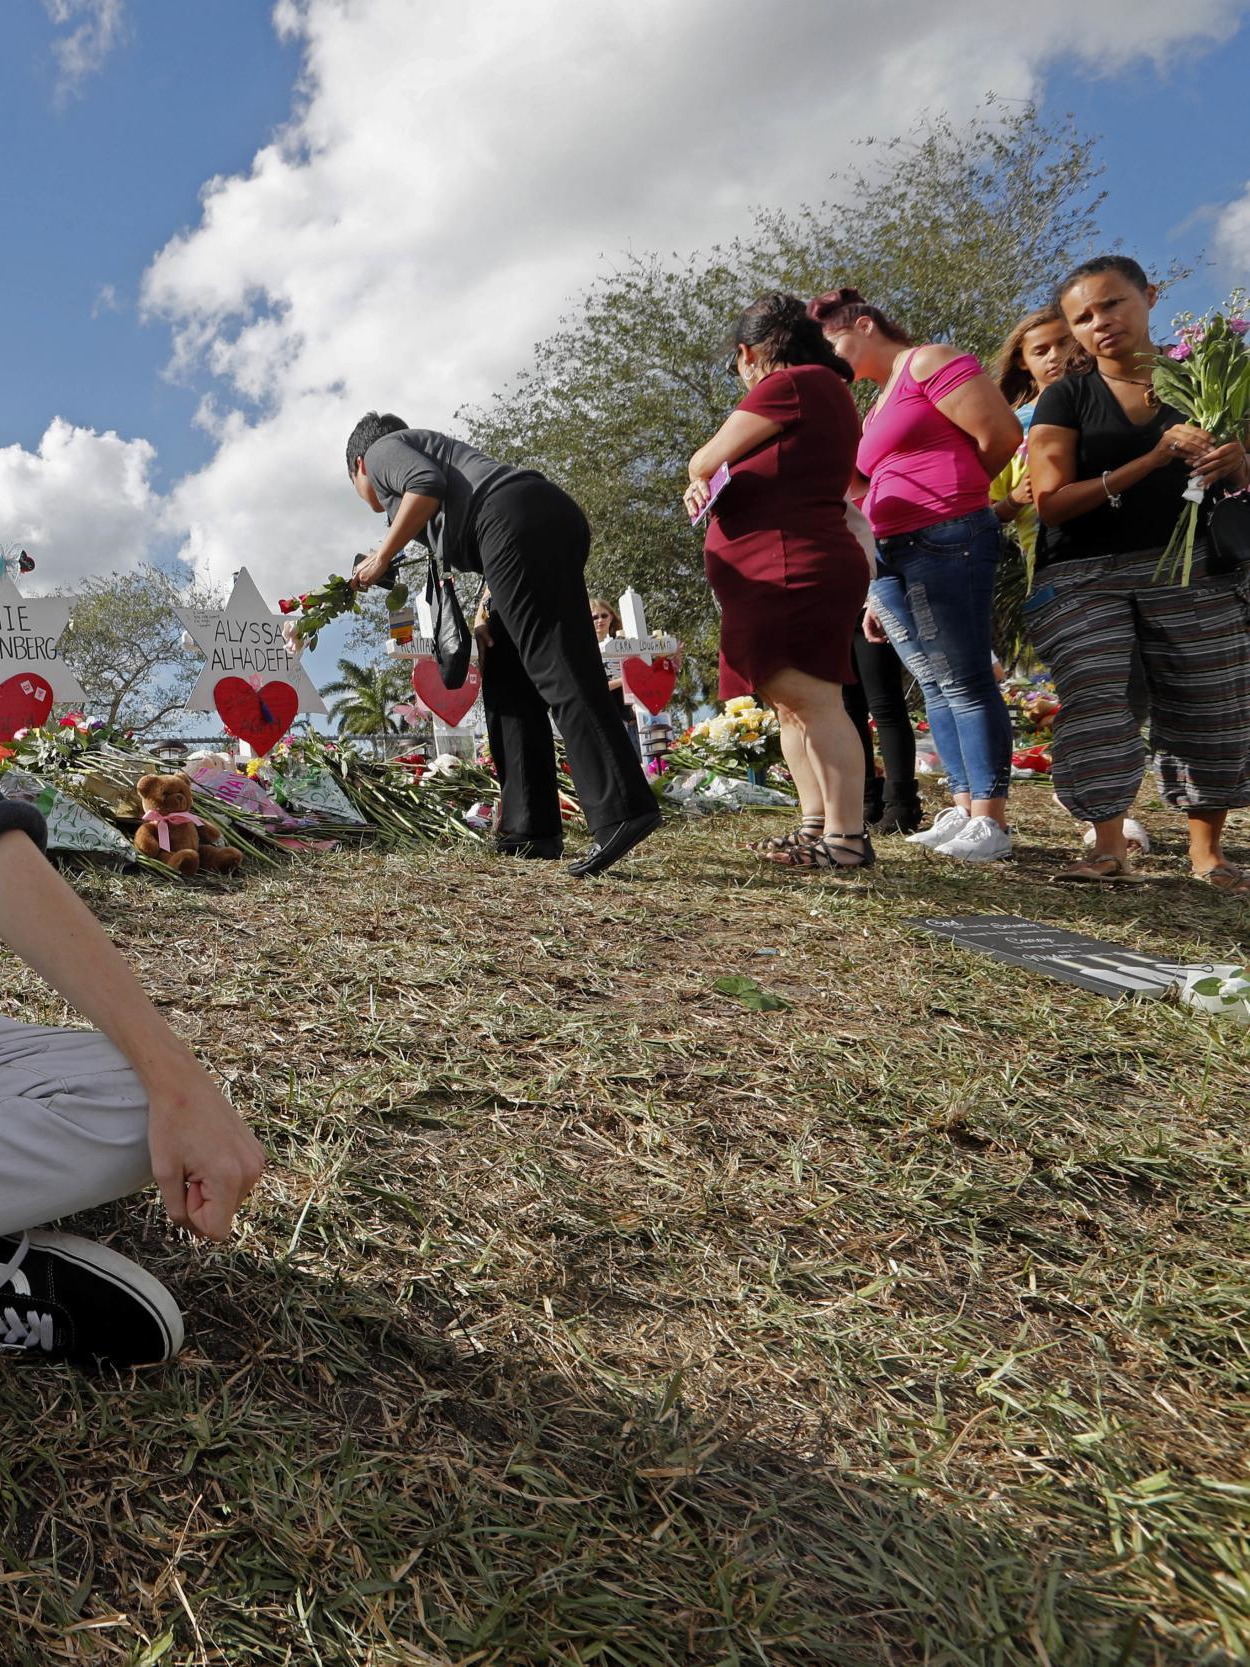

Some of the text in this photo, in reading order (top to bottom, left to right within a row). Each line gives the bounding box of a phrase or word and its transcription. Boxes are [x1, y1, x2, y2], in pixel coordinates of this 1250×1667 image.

[214, 619, 286, 645] ALYSSA
[614, 640, 632, 652] CARA
[211, 647, 294, 672] ALHADEFF
